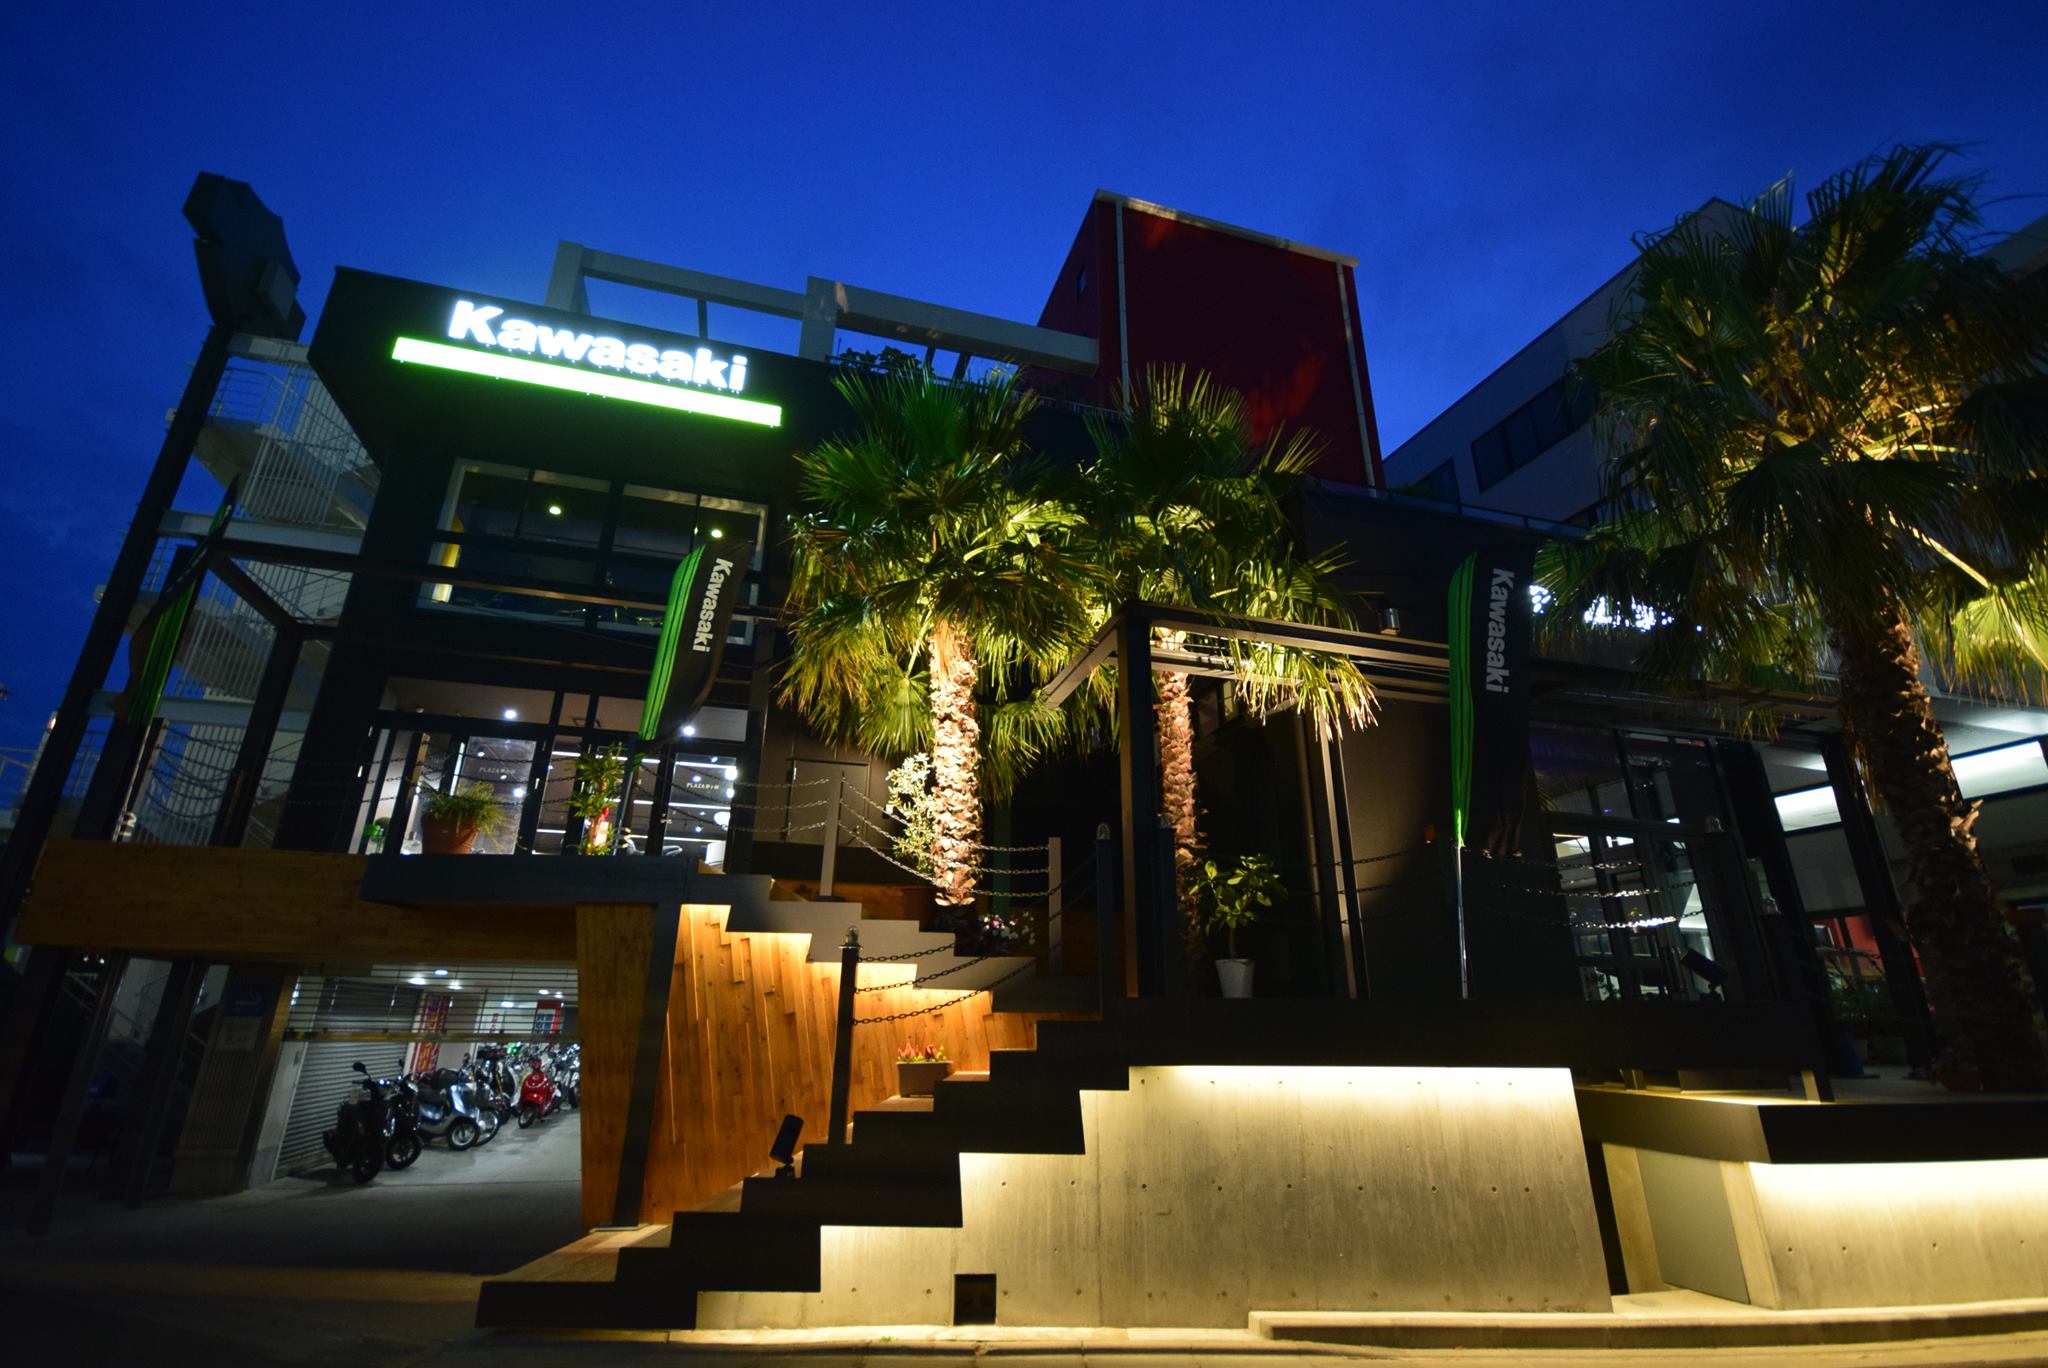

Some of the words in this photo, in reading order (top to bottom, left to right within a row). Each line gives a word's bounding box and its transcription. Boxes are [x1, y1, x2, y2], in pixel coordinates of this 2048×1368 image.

[448, 299, 748, 392] Kawasaki
[692, 557, 734, 653] Kawasaki
[1485, 567, 1515, 694] Kawasaki
